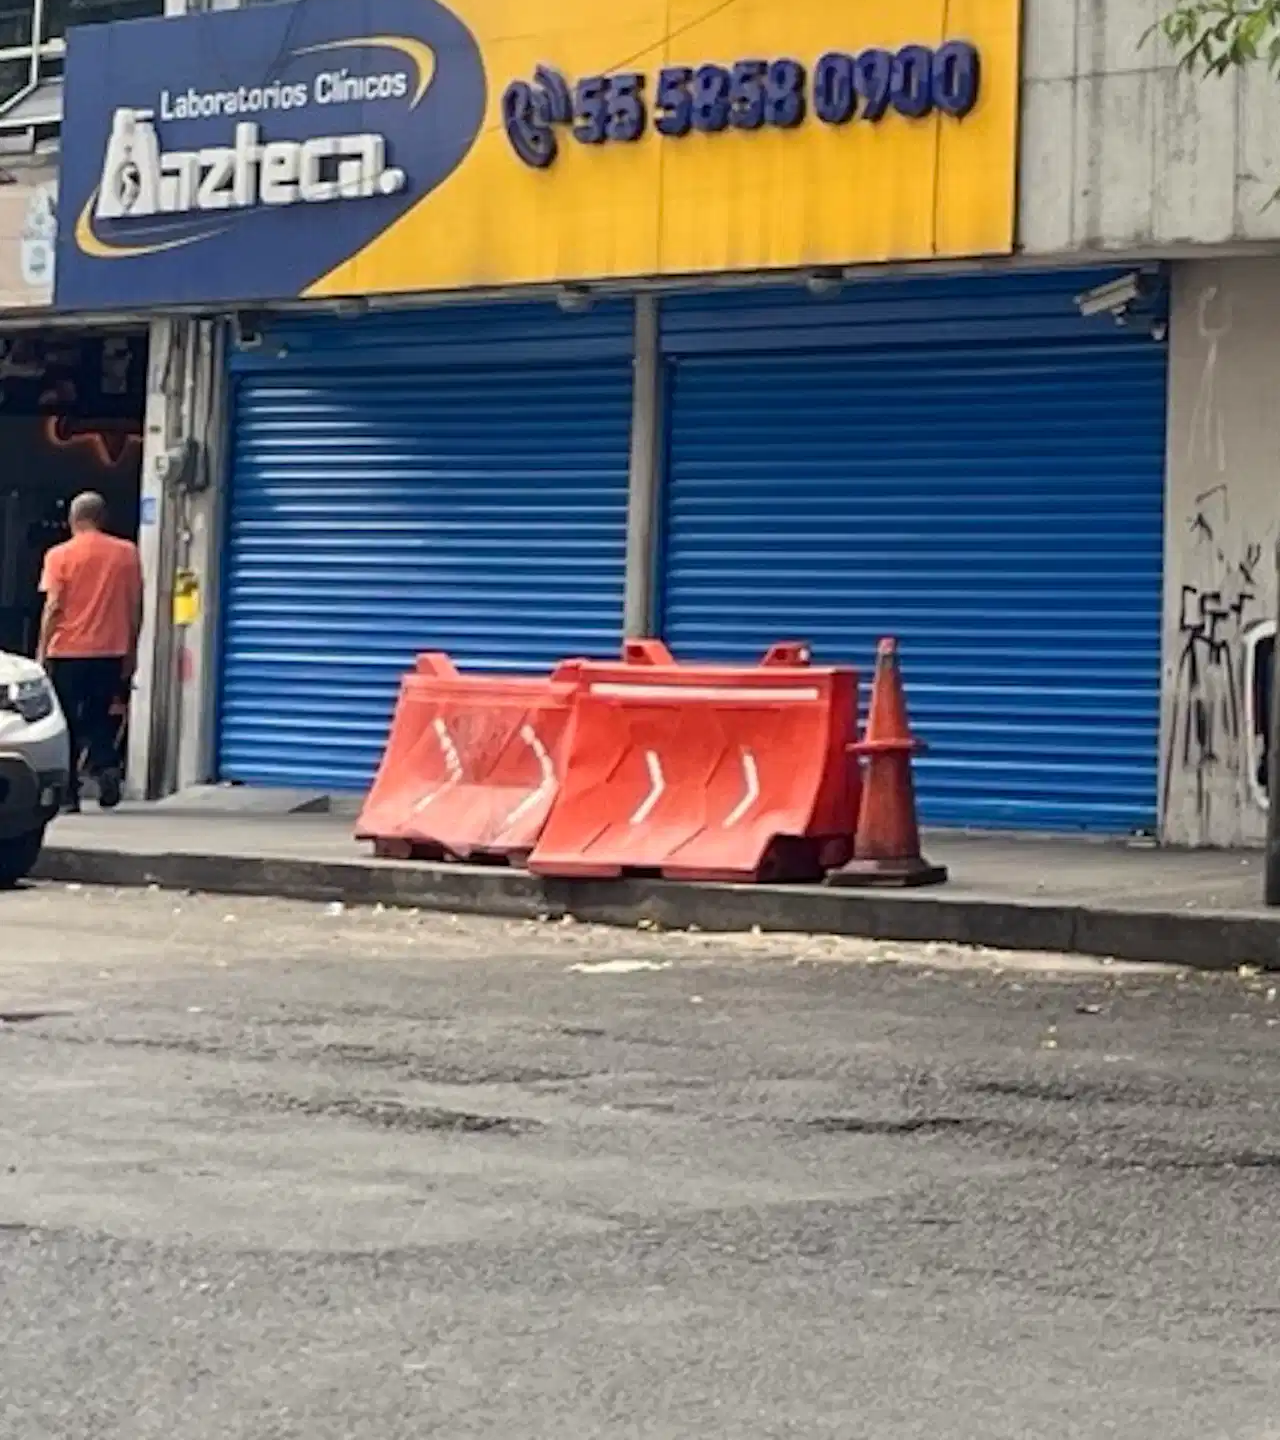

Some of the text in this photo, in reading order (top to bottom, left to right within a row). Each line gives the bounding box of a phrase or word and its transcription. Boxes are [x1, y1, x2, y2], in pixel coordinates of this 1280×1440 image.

[160, 69, 408, 121] Laboratorios Clínicos
[572, 40, 981, 144] 55 5858 0900
